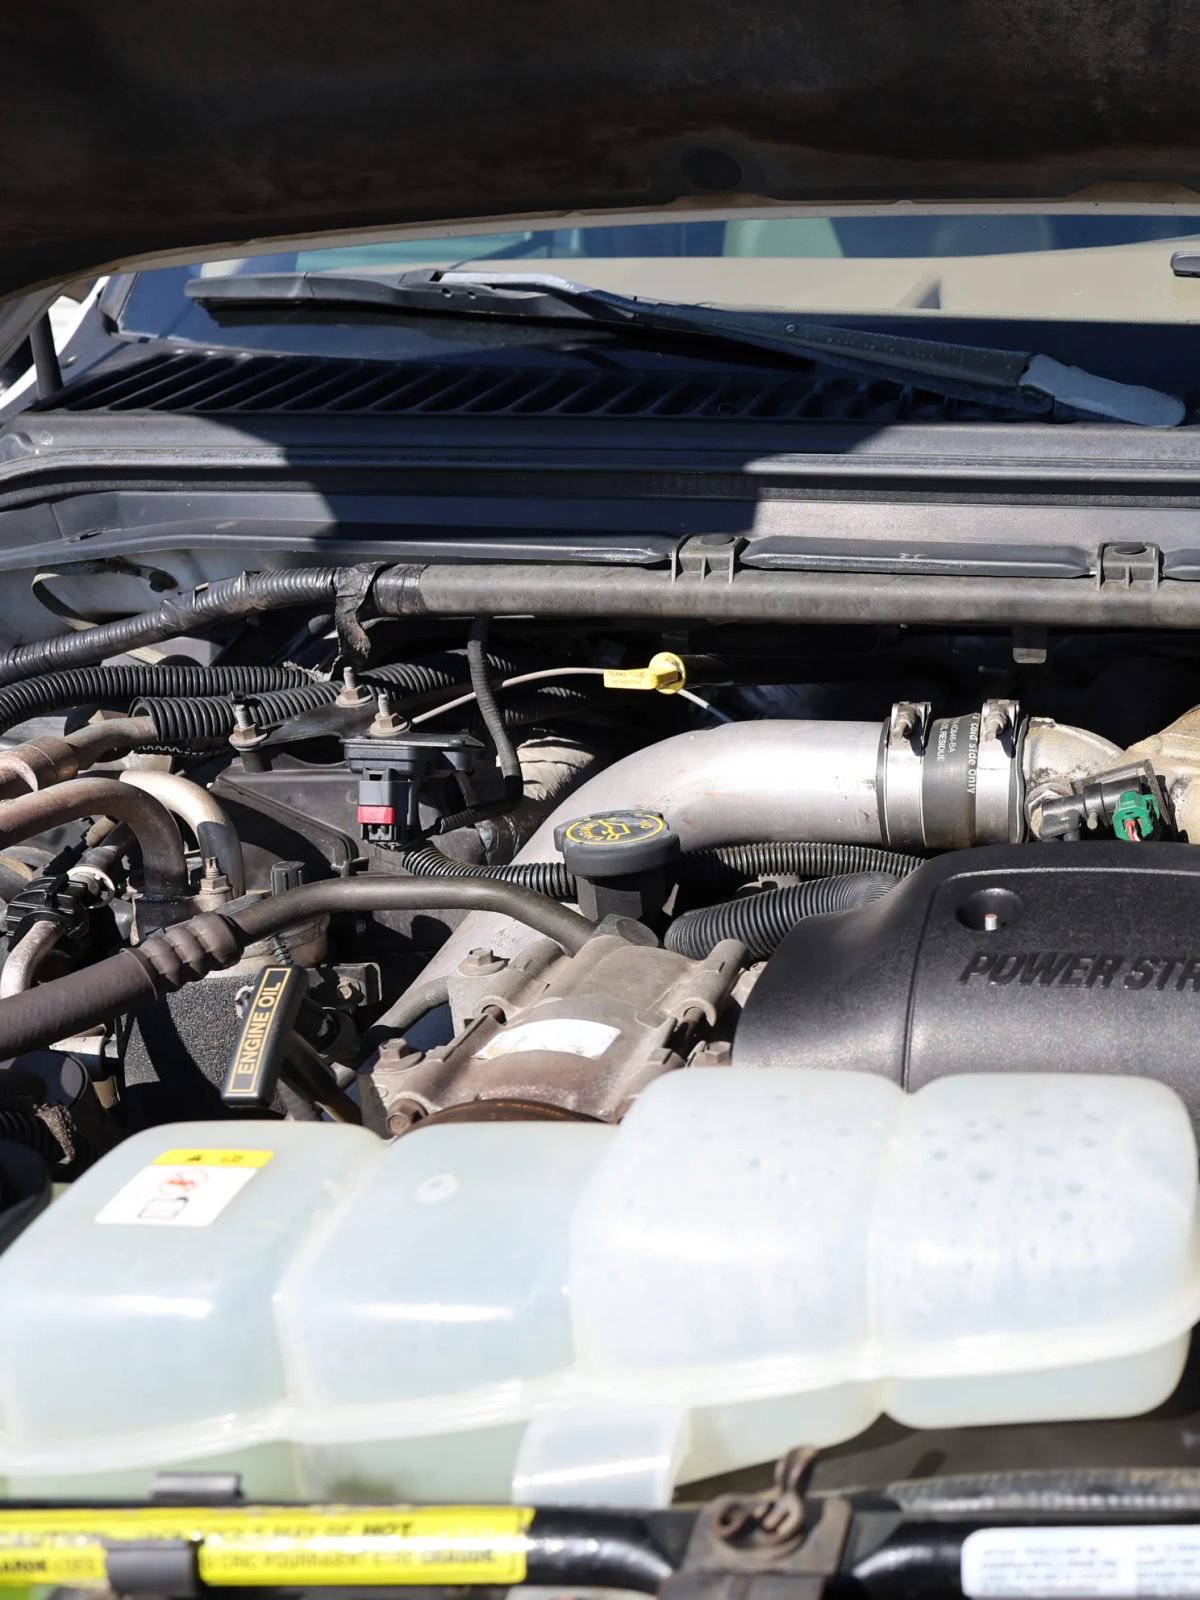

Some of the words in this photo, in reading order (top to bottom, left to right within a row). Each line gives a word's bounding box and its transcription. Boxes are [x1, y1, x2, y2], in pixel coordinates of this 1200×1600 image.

[937, 731, 948, 762] RESIDUE
[957, 951, 1126, 990] POWER
[237, 1011, 270, 1075] ENGINE
[257, 982, 282, 1008] OIL
